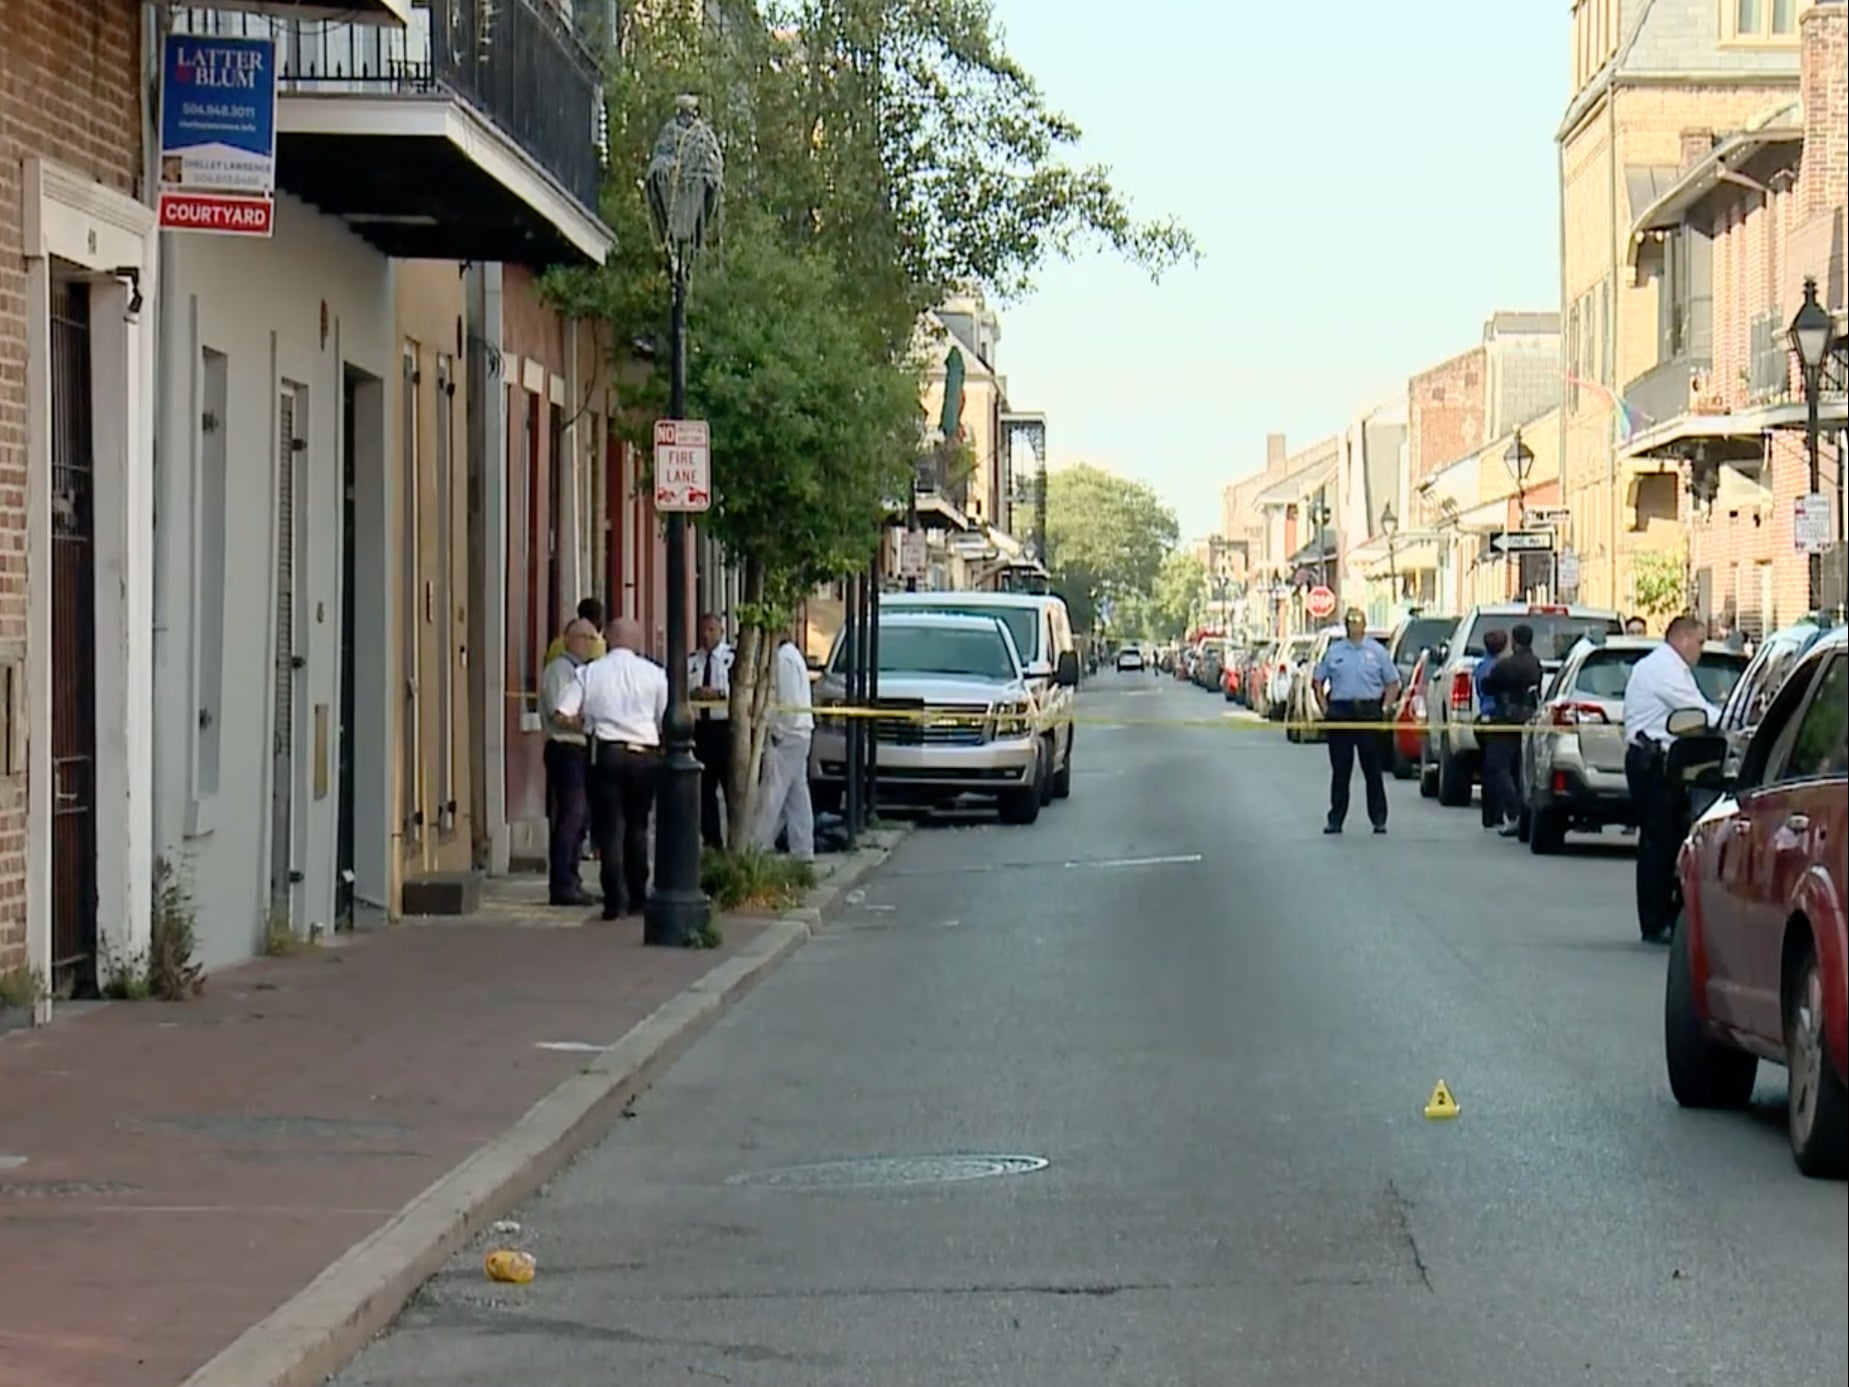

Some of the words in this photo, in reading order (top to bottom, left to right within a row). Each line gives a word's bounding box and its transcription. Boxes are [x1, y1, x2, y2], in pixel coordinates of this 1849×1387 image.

[177, 47, 264, 70] LATTER
[195, 67, 256, 89] BLUM
[165, 203, 266, 226] COURTYARD
[658, 426, 674, 442] NO
[669, 451, 695, 465] FIRE
[667, 469, 698, 484] LANE
[1308, 594, 1334, 608] STOP
[1438, 1091, 1446, 1105] 2
